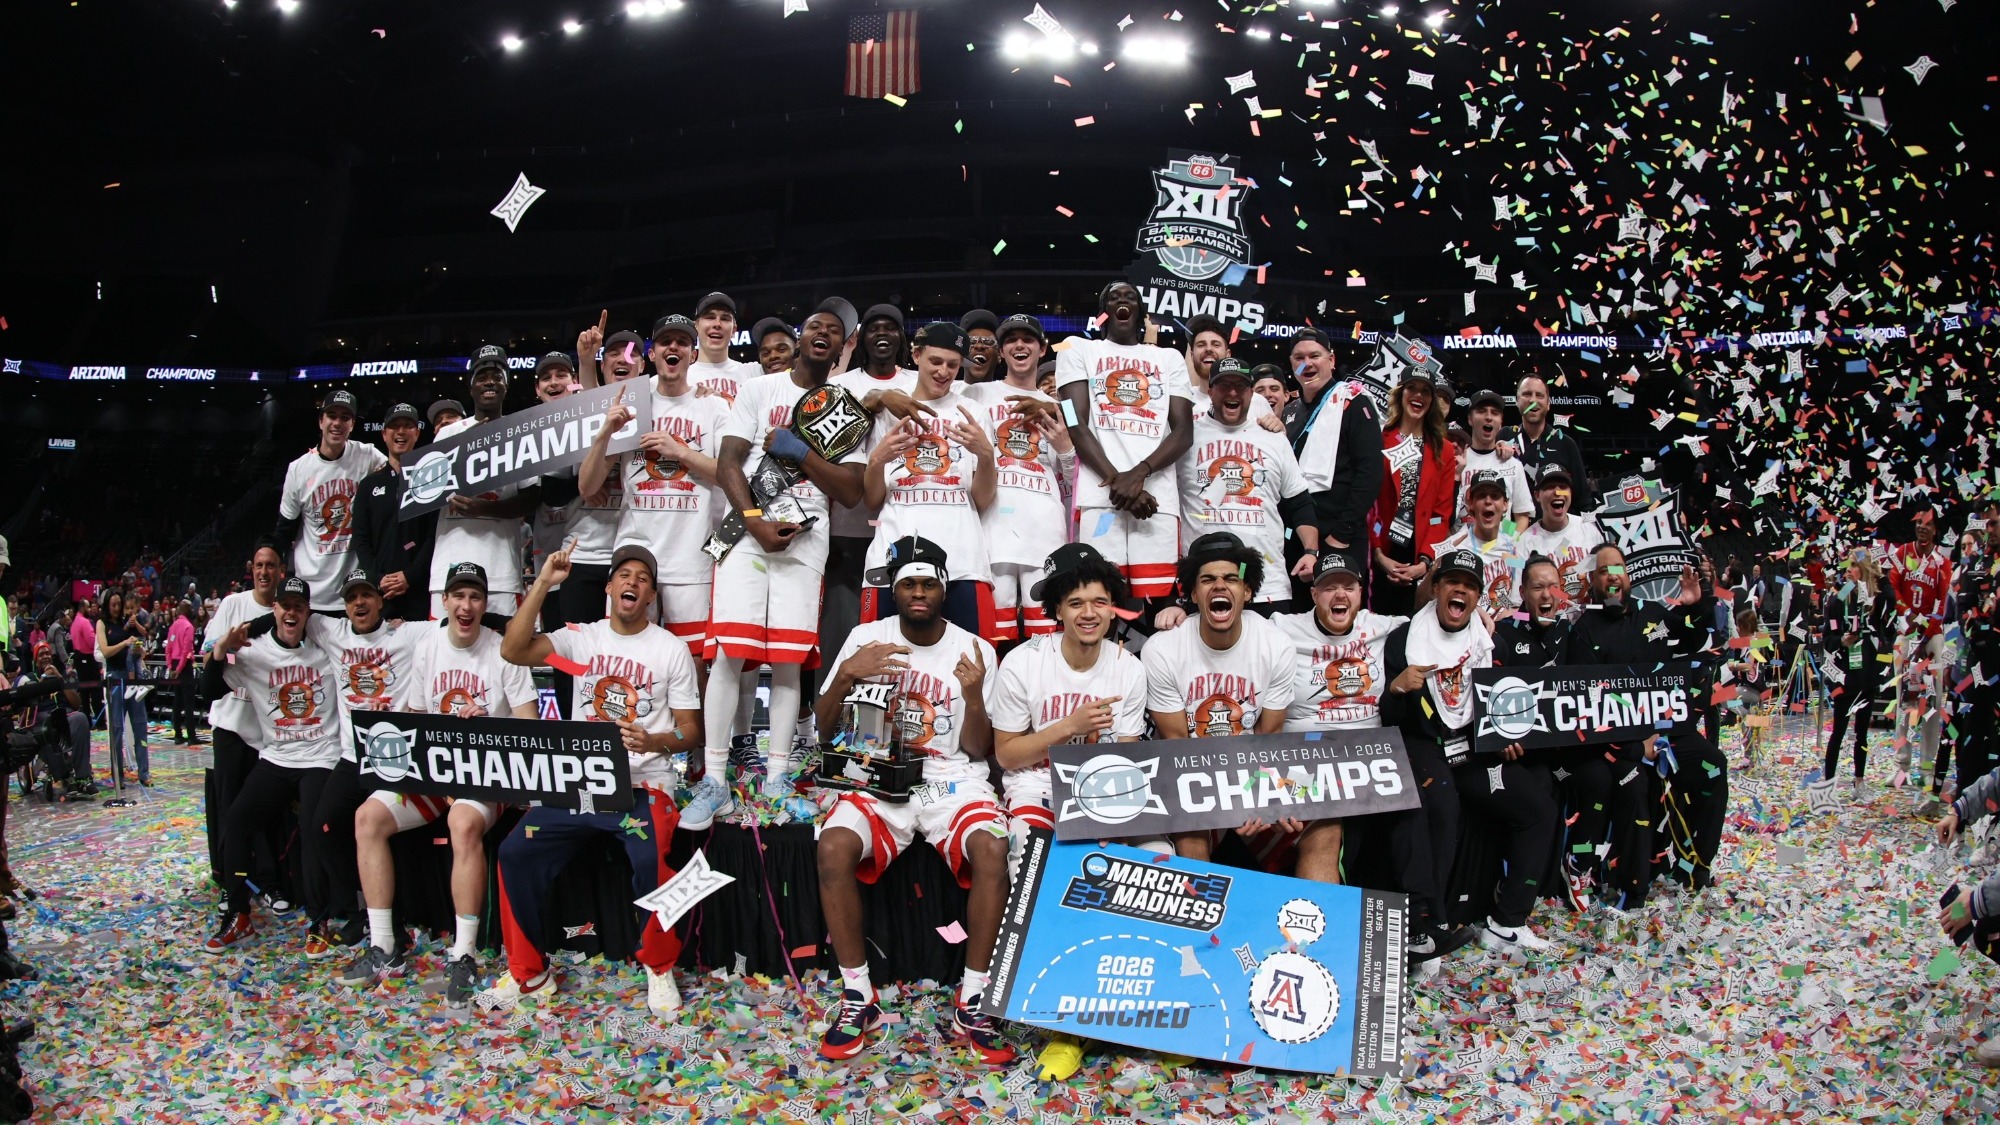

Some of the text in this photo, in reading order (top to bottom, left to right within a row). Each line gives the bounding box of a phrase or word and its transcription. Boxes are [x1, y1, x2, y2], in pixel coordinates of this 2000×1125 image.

[1192, 164, 1211, 177] 66
[1155, 179, 1240, 230] XII
[1144, 234, 1244, 257] TOURNAMENT
[1148, 225, 1242, 249] BASKETBALL
[1150, 276, 1229, 296] MEN'S BASKETBALL
[1135, 286, 1266, 331] HAMPS
[1443, 335, 1516, 349] ARIZONA
[1541, 336, 1617, 349] CHAMPIONS
[68, 366, 216, 381] ARIZONA CHAMPIONS
[350, 359, 418, 377] ARIZONA
[466, 356, 537, 370] CIONS
[1095, 355, 1162, 383] ARIZONA
[1117, 379, 1140, 392] XII
[1574, 398, 1600, 406] CENTER
[466, 431, 502, 452] MEN'S
[507, 405, 585, 439] BASKETBALL
[651, 415, 703, 449] IZONA
[1009, 429, 1030, 442] XII
[1098, 415, 1161, 436] WILDCATS
[48, 437, 76, 448] UMB
[465, 405, 638, 485] CHAMPS
[916, 446, 939, 459] XII
[1196, 439, 1265, 468] ARIZONA
[1219, 466, 1244, 480] XII
[633, 495, 699, 510] WILDCATS
[891, 489, 966, 505] WILDCATS
[1625, 488, 1641, 500] 66
[1203, 510, 1266, 524] WILDCATS
[1602, 499, 1683, 556] XII
[1626, 554, 1693, 574] SKETBALL
[1311, 639, 1376, 667] ARIZONA
[268, 664, 323, 689] ARIZONA
[587, 653, 654, 697] ARIZONA
[1337, 665, 1361, 680] XII
[1552, 675, 1685, 692] MEN'S BASKETBALL 2026
[432, 668, 487, 701] ARIZONA
[1186, 672, 1258, 709] ARIZONA
[286, 692, 306, 705] XII
[602, 685, 629, 708] XII
[843, 682, 899, 711] XII
[1208, 709, 1232, 725] XII
[1318, 705, 1377, 722] WILDCAT
[1553, 689, 1689, 732] CHAMPS
[274, 726, 326, 741] WILDCATS
[425, 730, 612, 752] MEN'S BASKETBALL 2026
[1174, 743, 1393, 769] MEN'S BASKETBALL 2026
[427, 746, 617, 796] CHAMPS
[1177, 758, 1403, 814] CHAMPS
[1086, 862, 1107, 875] NCAA
[1106, 861, 1190, 894] MARCH
[1013, 837, 1046, 926] @MARCHMADNESSMBB
[1111, 885, 1225, 924] MADNESS
[1284, 910, 1318, 933] XII
[1375, 912, 1383, 932] SEAT
[991, 932, 1020, 1008] #MARCHMADNESS
[1096, 954, 1156, 977] 2026
[1373, 961, 1382, 993] ROW 15
[1096, 977, 1156, 997] TICKET
[1357, 897, 1374, 1070] NCAA TOURNAMENT AUTOMATIC QUALIFIER
[1261, 969, 1307, 1025] A
[1056, 995, 1191, 1029] PUNCHED
[1367, 1030, 1378, 1069] SECTION
